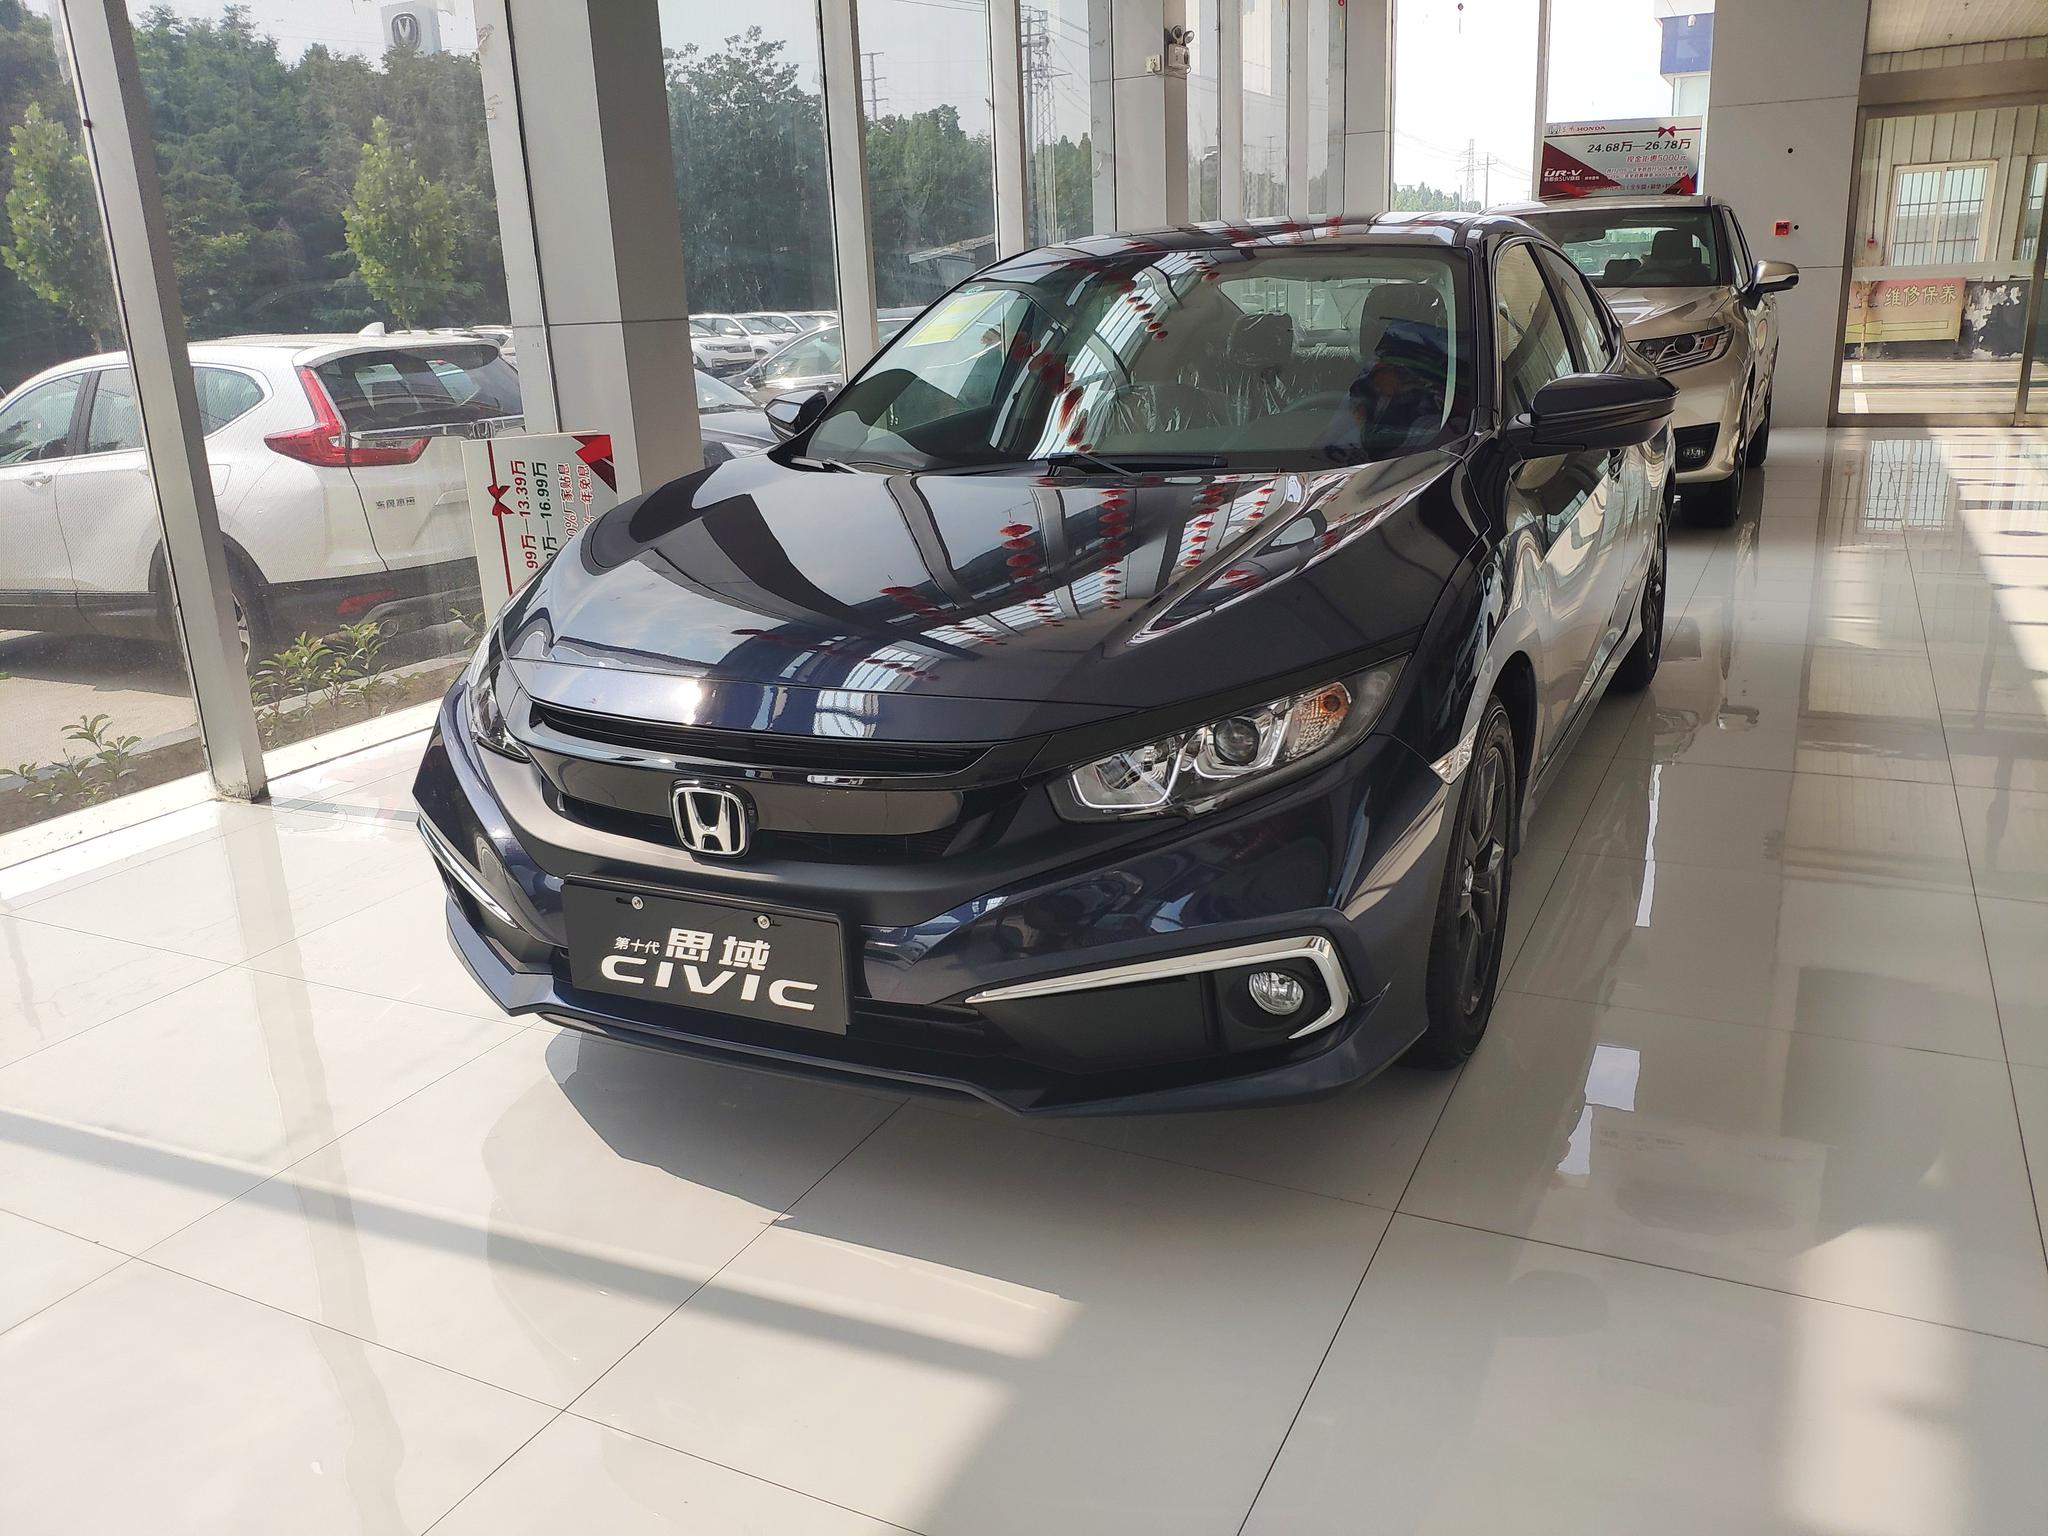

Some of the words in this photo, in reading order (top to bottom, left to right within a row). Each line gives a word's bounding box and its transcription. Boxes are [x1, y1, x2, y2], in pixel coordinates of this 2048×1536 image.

[1884, 285, 1957, 307] 维修保养
[557, 463, 578, 541] 0%厂家贴息
[613, 935, 661, 955] 第十代
[665, 927, 771, 971] 思域
[601, 955, 818, 1011] CIVIC
